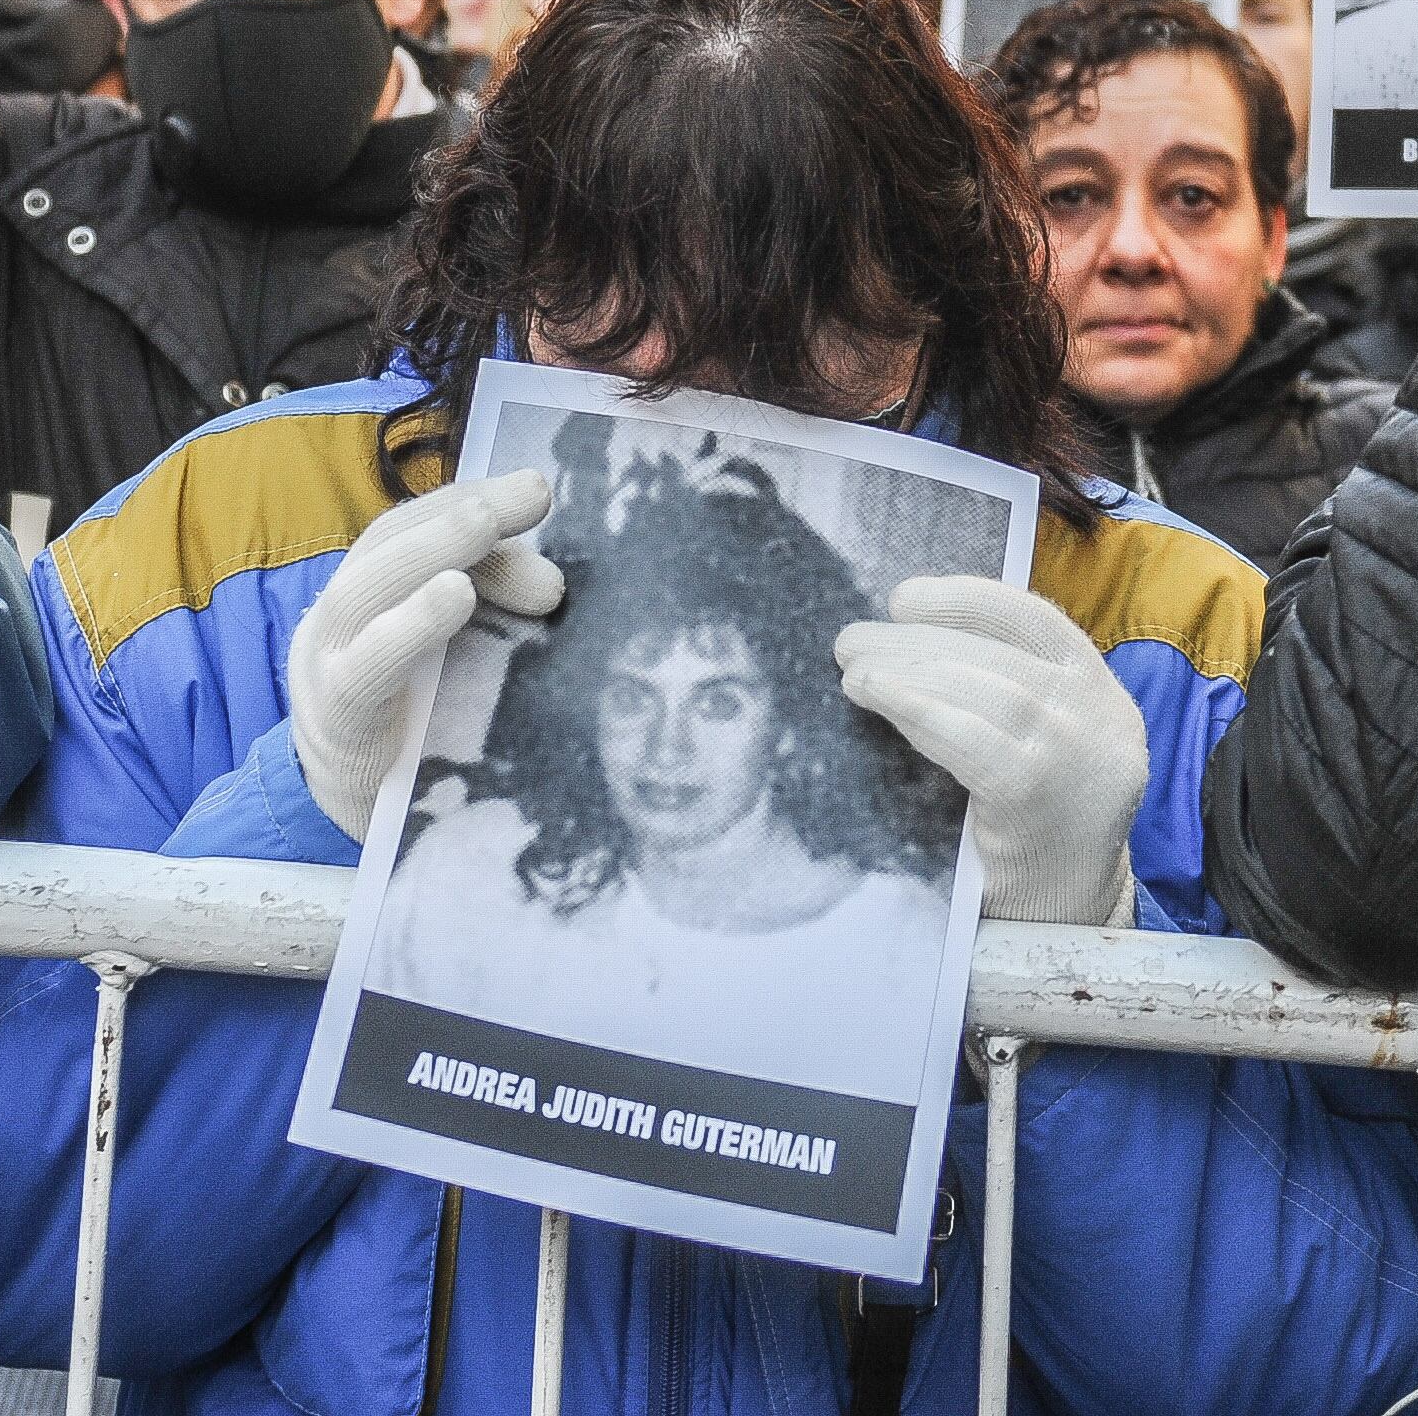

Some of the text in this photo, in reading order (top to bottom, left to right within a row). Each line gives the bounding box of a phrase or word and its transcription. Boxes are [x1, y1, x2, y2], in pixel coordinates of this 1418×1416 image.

[407, 1051, 837, 1176] ANDREA JUDITH GUTERMAN
